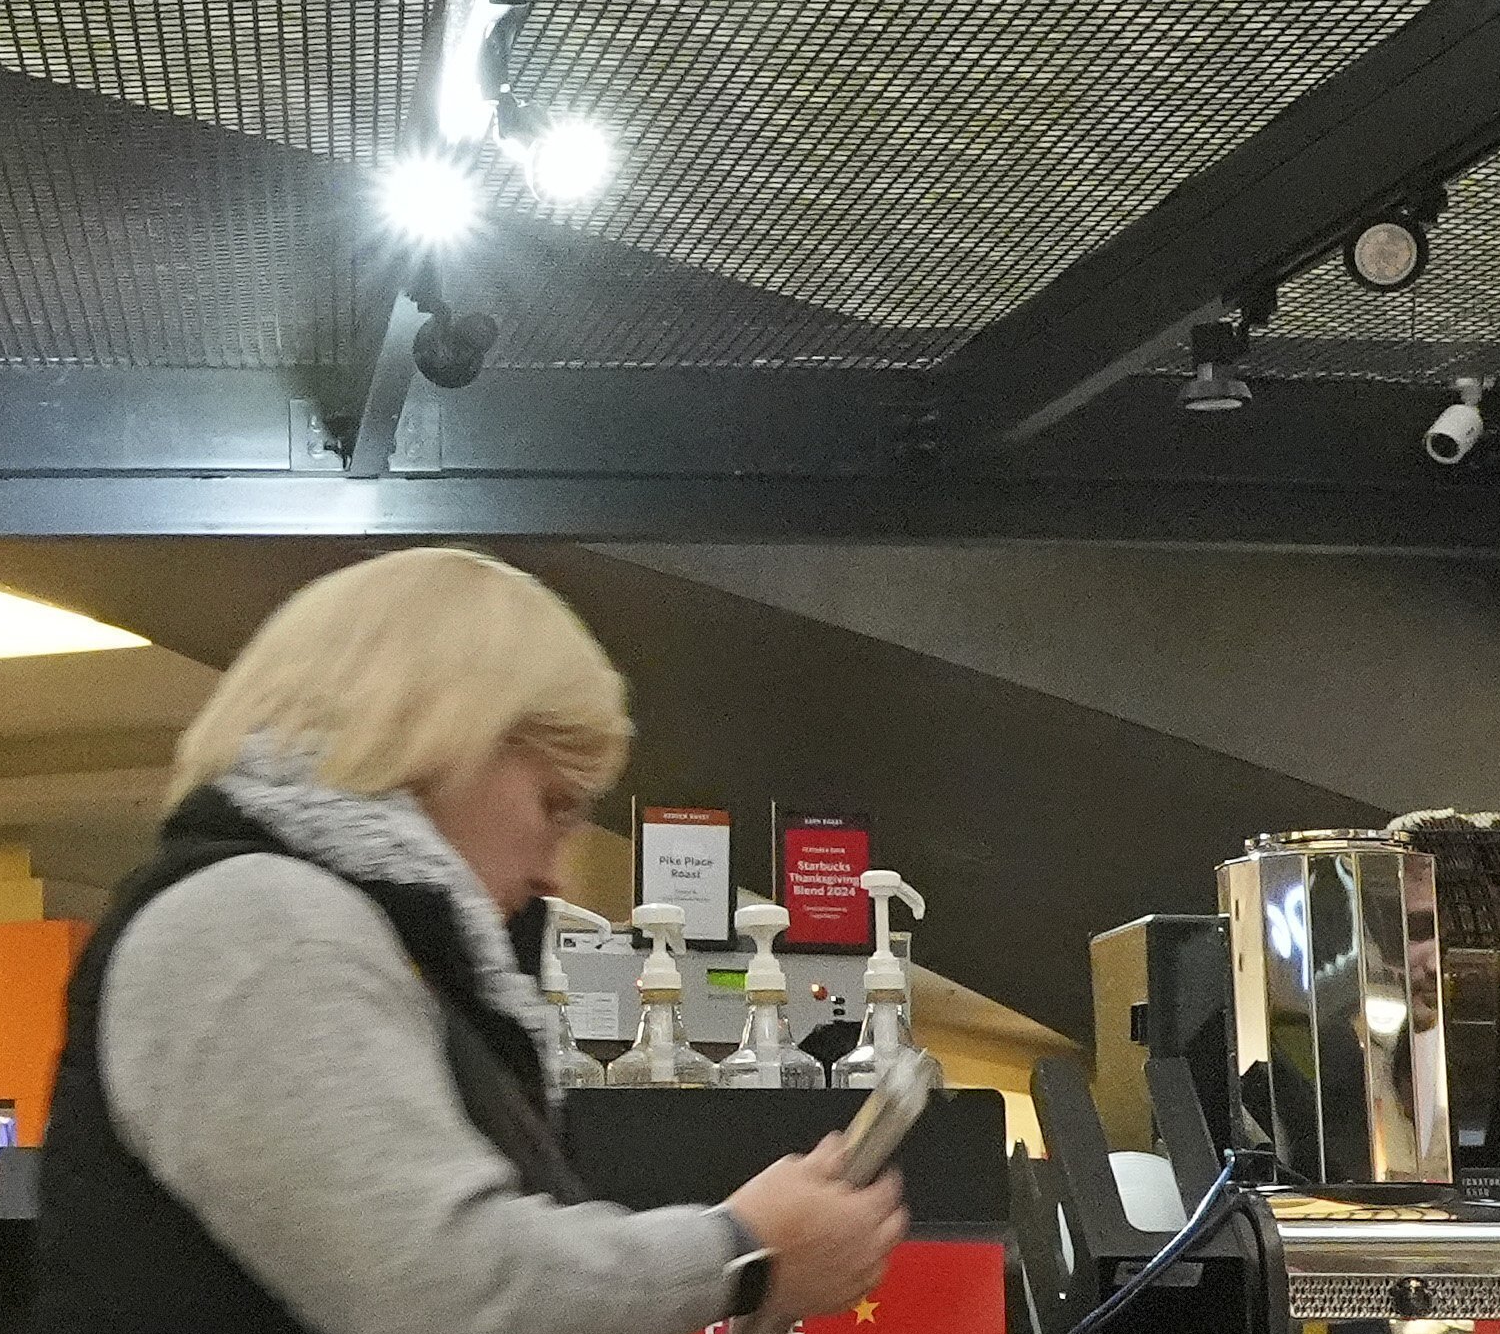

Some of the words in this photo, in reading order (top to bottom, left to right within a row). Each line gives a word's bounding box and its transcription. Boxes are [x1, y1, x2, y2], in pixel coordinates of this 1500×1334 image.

[660, 856, 681, 865] Pike
[684, 857, 714, 866] Place
[797, 861, 850, 872] Starbucks
[671, 869, 701, 878] Roast
[788, 872, 860, 887] Thanksgiving
[793, 885, 825, 895] Blend
[827, 886, 856, 896] 2024
